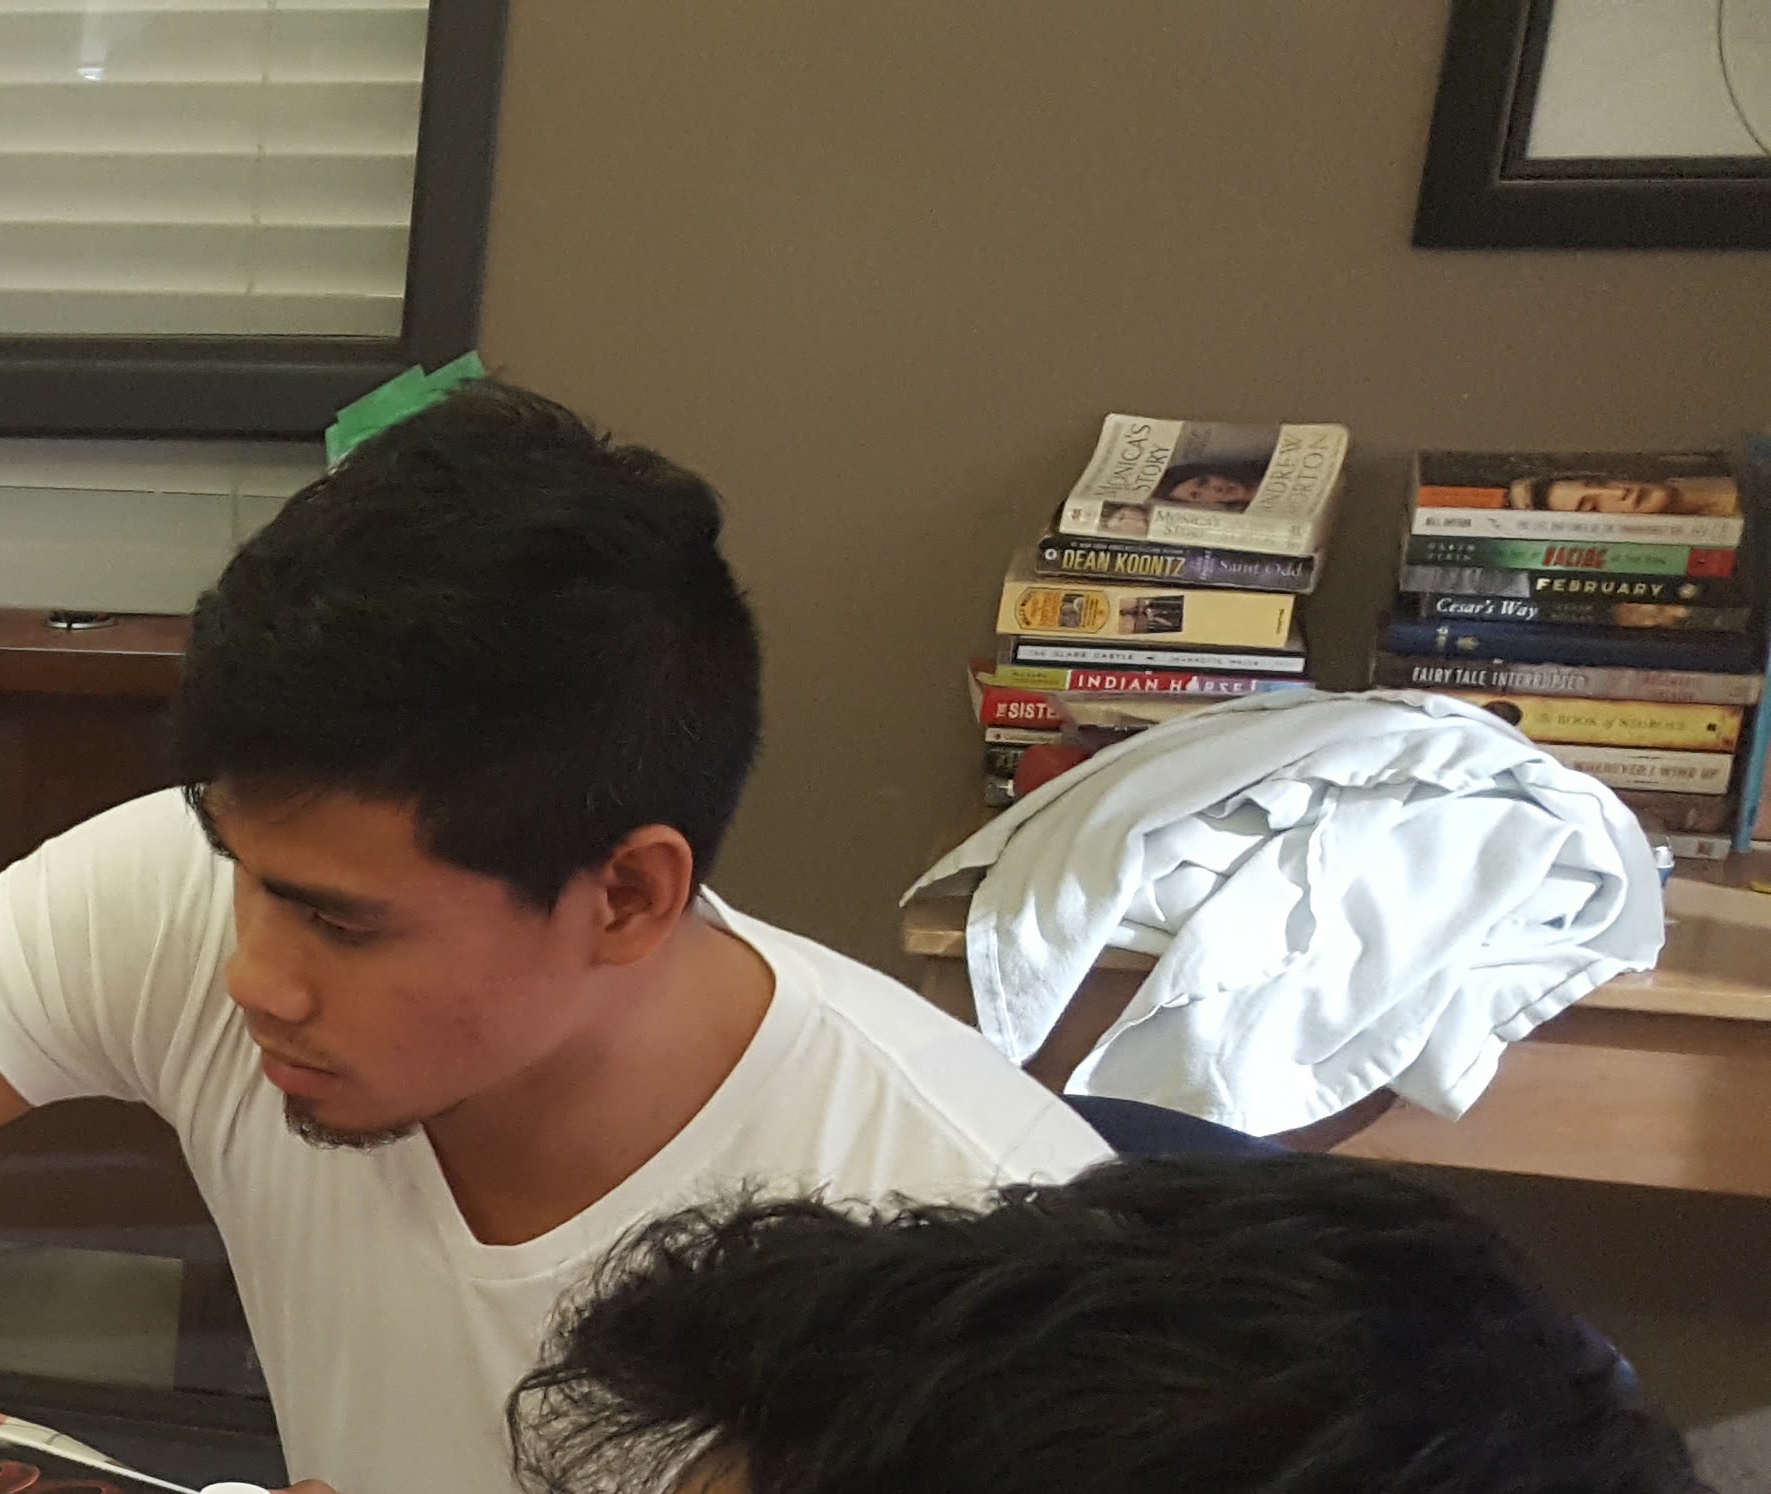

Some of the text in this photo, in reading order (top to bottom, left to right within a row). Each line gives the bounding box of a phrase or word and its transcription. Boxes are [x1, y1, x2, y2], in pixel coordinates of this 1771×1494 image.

[1133, 446, 1170, 492] STORY
[1062, 549, 1186, 577] DEAN KOONTZ
[1536, 577, 1665, 596] FEBRUARY
[1436, 597, 1495, 615] Cesar's
[1500, 600, 1539, 620] Way
[1077, 674, 1159, 692] INDIAN
[1412, 666, 1451, 684] FAIRY
[1455, 668, 1487, 686] TALE
